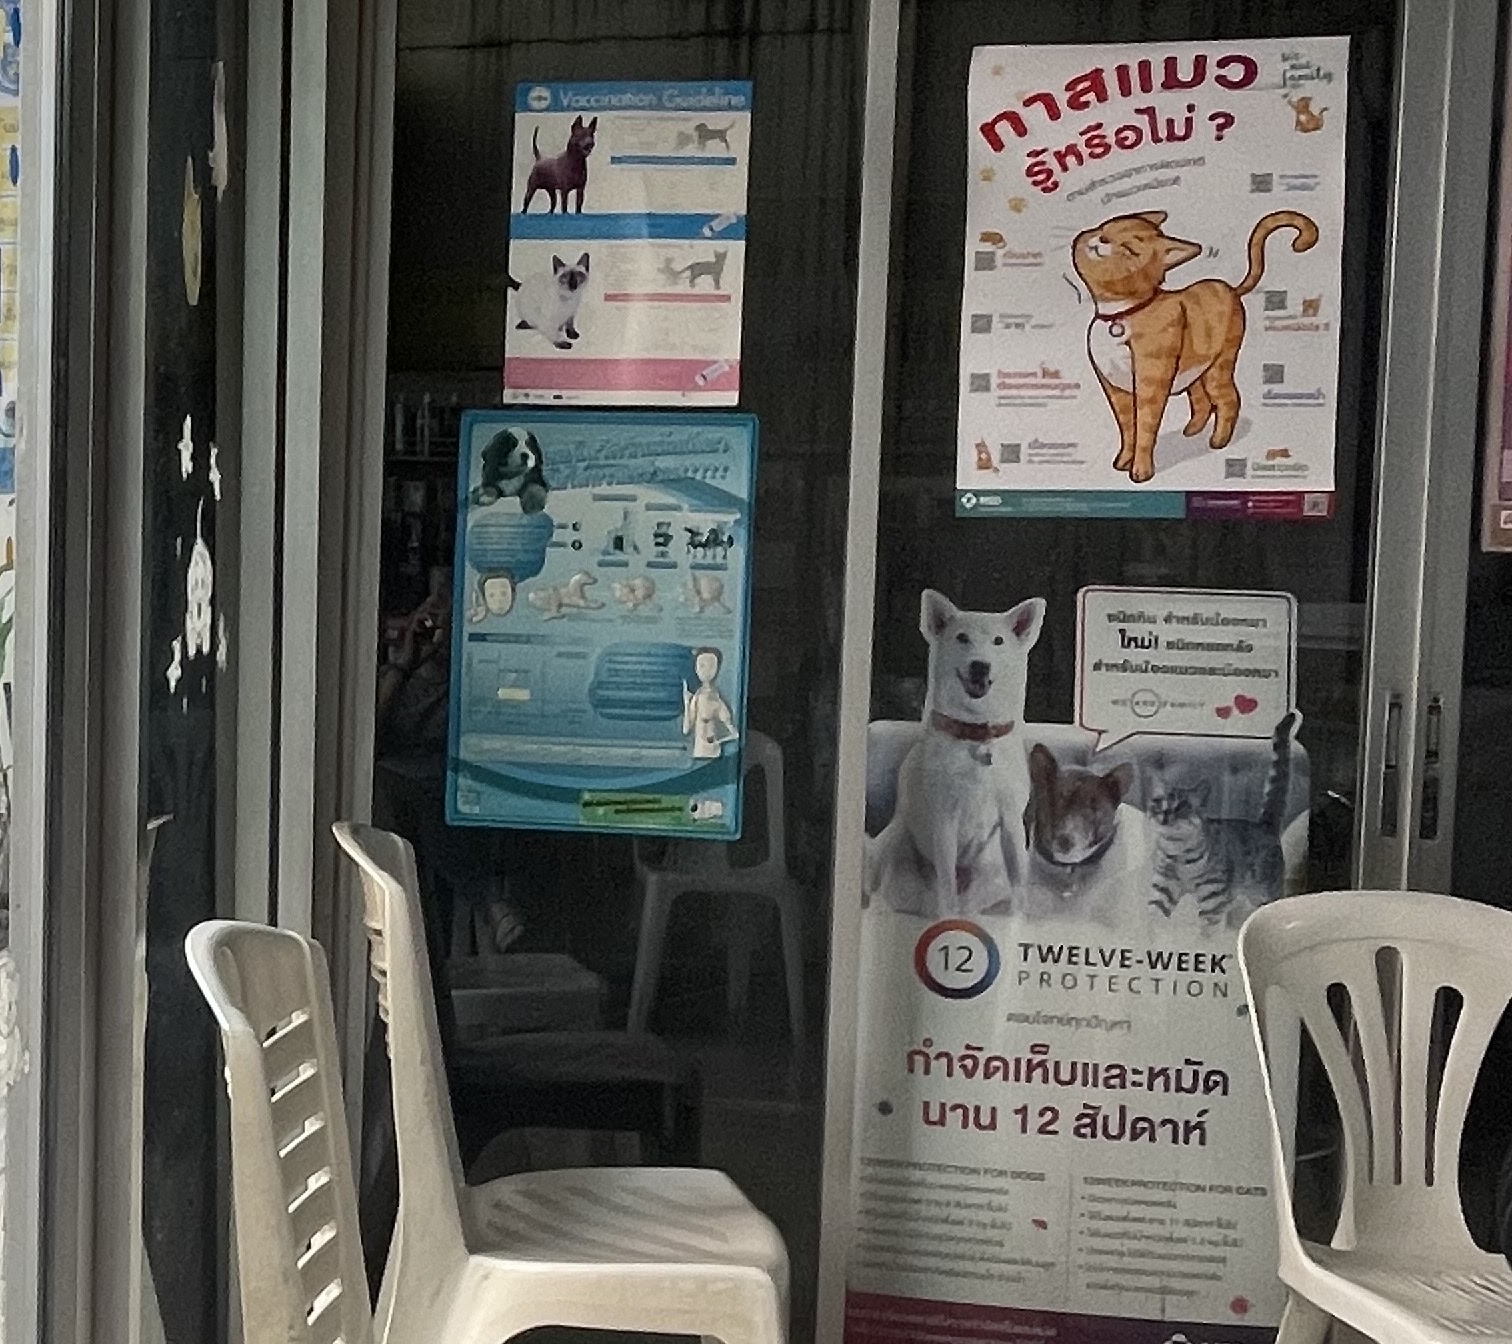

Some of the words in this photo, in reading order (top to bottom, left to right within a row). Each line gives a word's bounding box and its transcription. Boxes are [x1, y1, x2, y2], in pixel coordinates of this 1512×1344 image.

[559, 88, 658, 108] Vaccination
[661, 86, 746, 108] Guideline
[979, 53, 1258, 153] ทาสแมว
[938, 945, 974, 974] 12
[1018, 942, 1229, 974] TWELVE-WEEK
[1018, 969, 1230, 999] PROTECTION
[906, 1037, 1230, 1097] กำจัดเห็บและหมัด
[922, 1100, 998, 1132] นาน
[1013, 1103, 1060, 1136] 12
[1072, 1101, 1210, 1147] สัปดาห์
